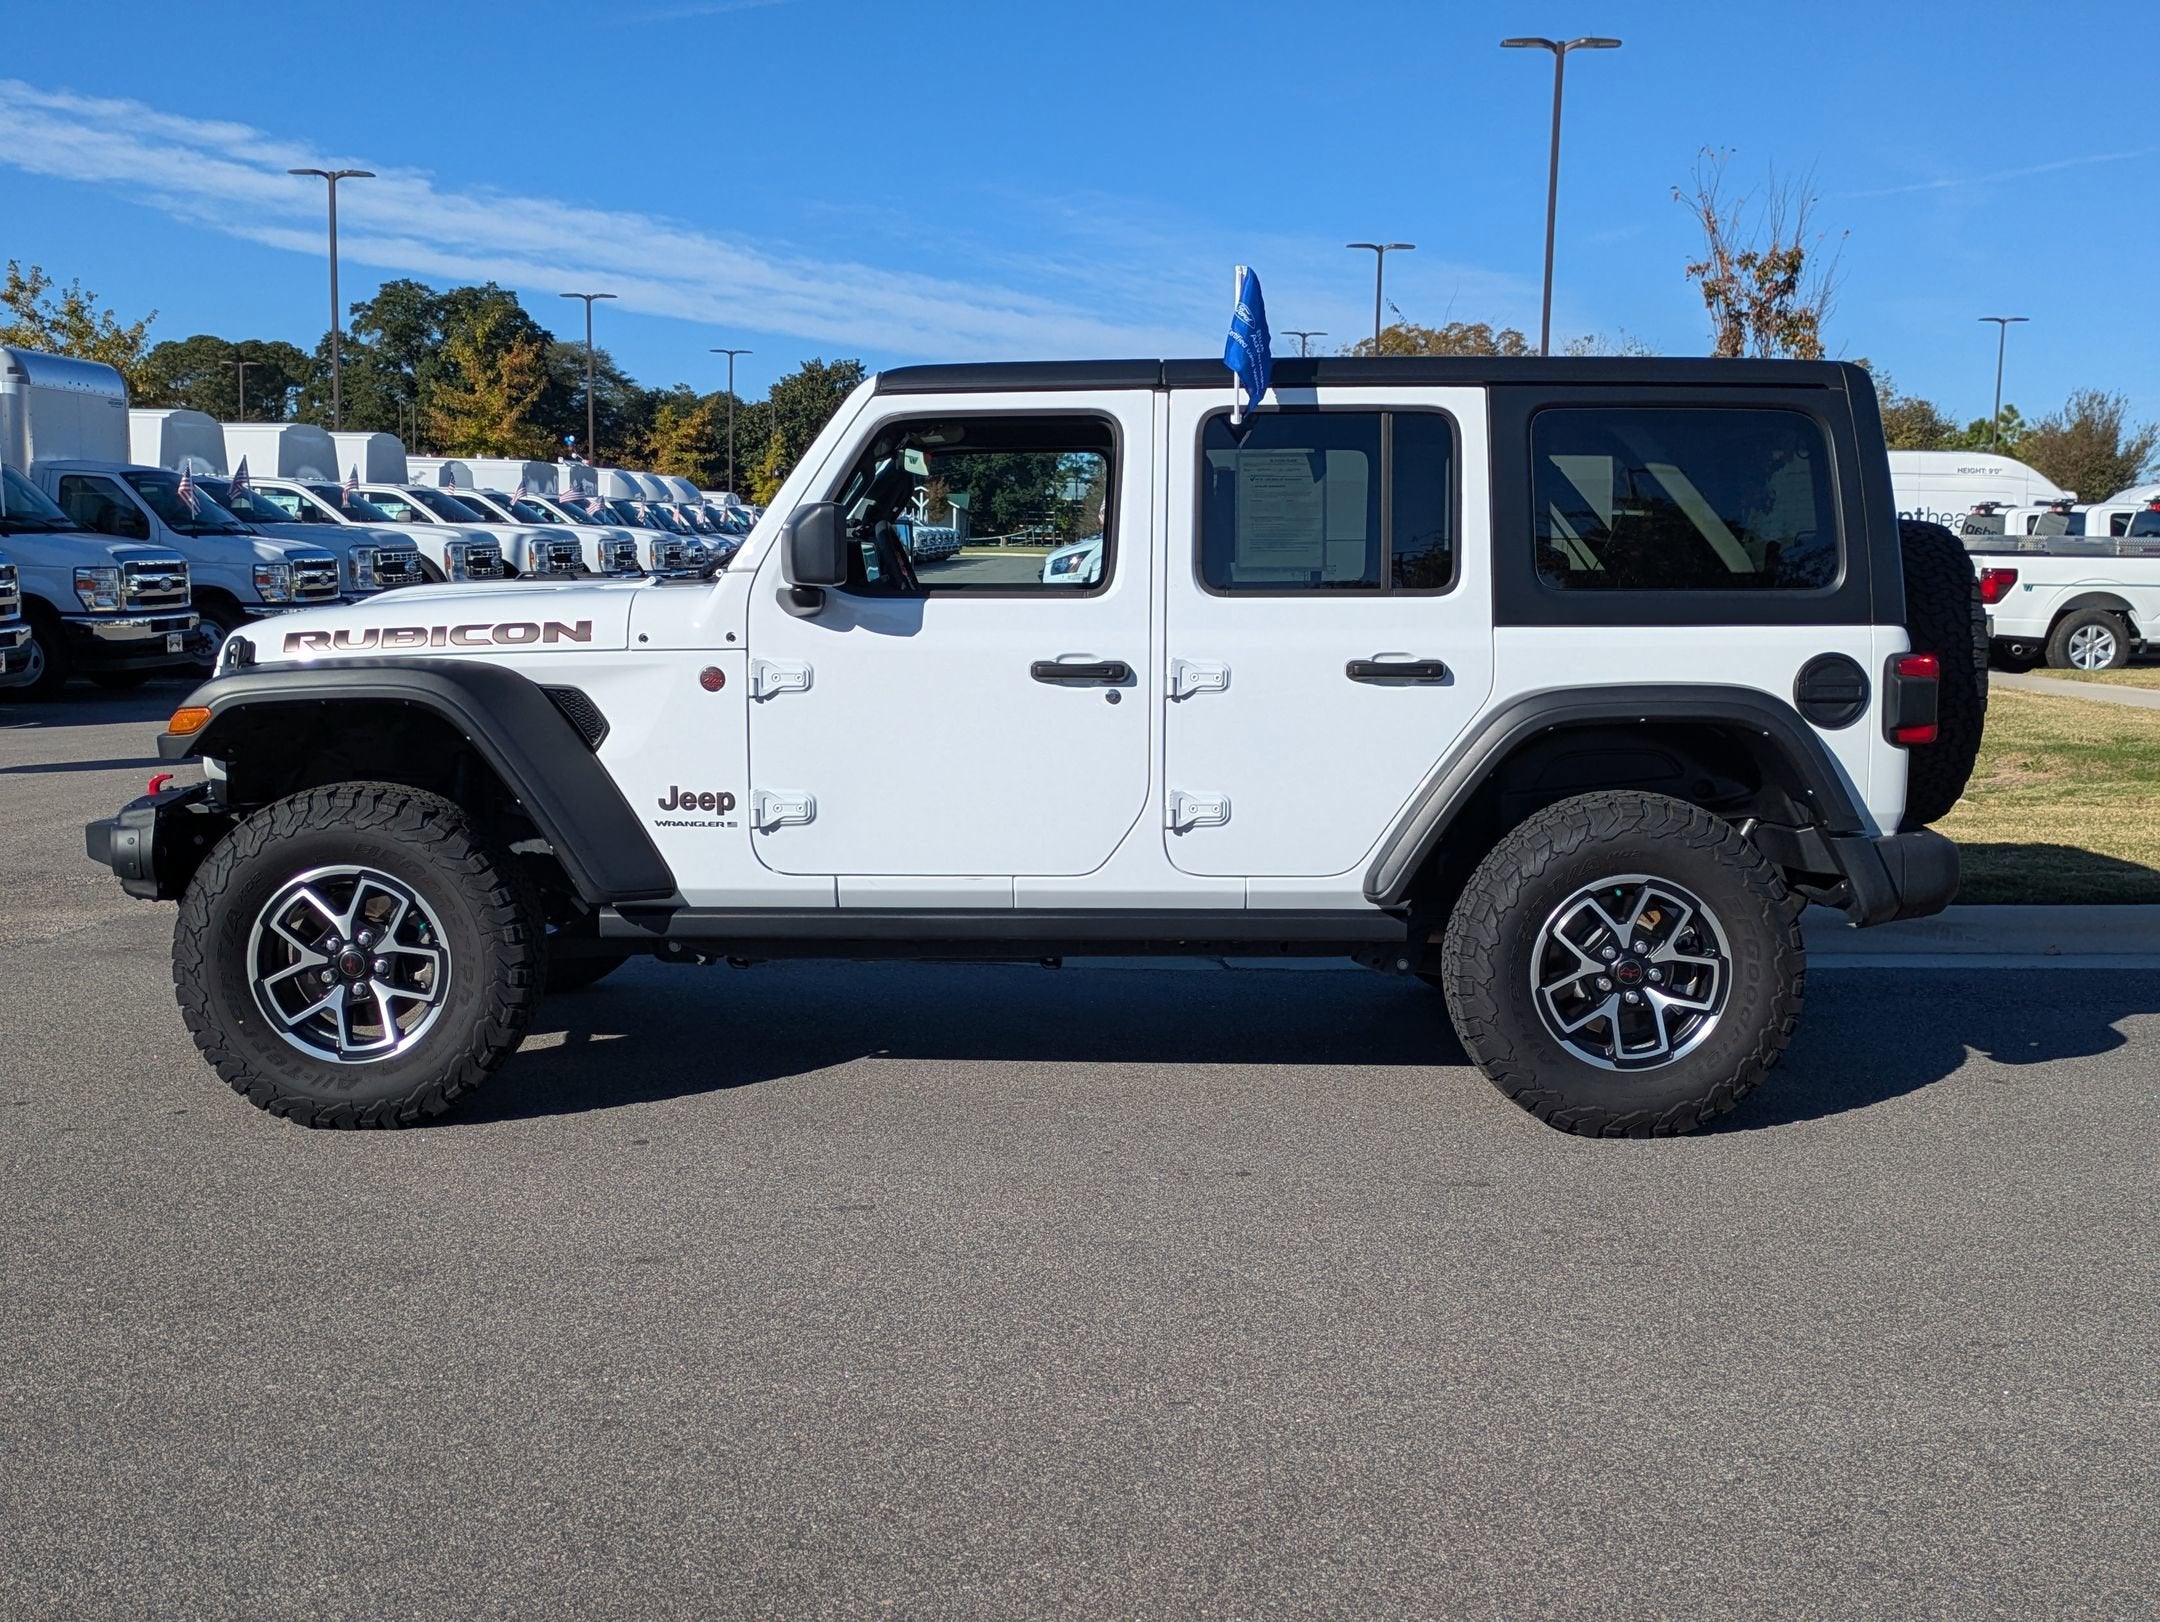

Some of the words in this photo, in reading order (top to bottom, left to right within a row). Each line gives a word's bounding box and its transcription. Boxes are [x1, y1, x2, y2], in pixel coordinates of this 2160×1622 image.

[1236, 304, 1253, 324] Ford
[1957, 467, 1987, 475] HEIGHT:
[283, 620, 592, 653] RUBICON
[657, 785, 736, 816] Jeep
[654, 820, 725, 828] WRANGLER
